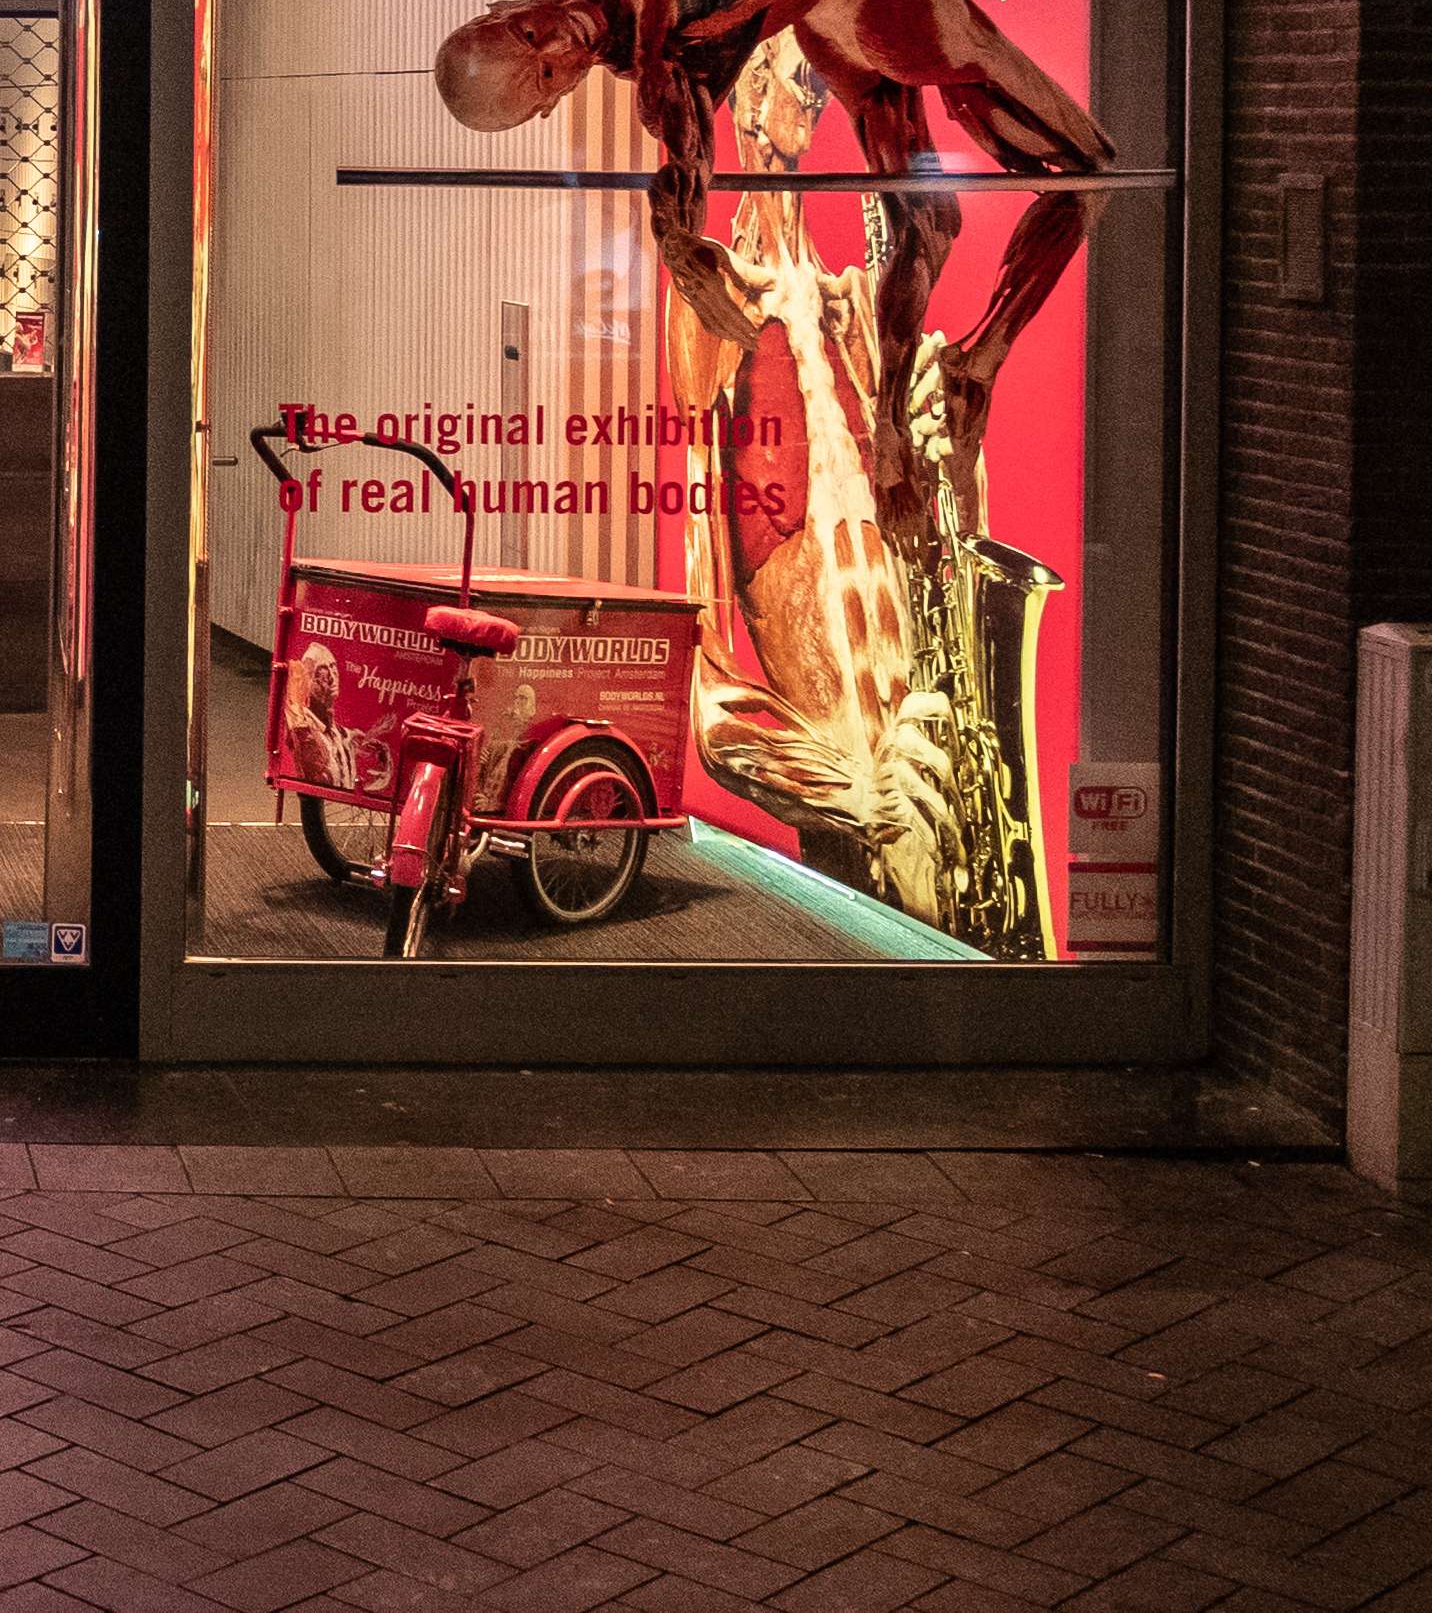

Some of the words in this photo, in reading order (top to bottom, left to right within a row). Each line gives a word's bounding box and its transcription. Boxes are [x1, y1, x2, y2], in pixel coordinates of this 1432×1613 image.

[279, 402, 358, 447] The
[376, 402, 544, 454] original
[279, 469, 324, 514] of
[341, 470, 429, 514] real
[454, 470, 608, 515] human
[630, 472, 786, 516] bodies
[300, 611, 357, 641] BODY
[358, 623, 446, 656] WORLDS
[496, 634, 567, 663] ODY
[568, 636, 671, 665] WORLDS
[358, 664, 442, 706] Happiness
[519, 666, 574, 680] Happiness
